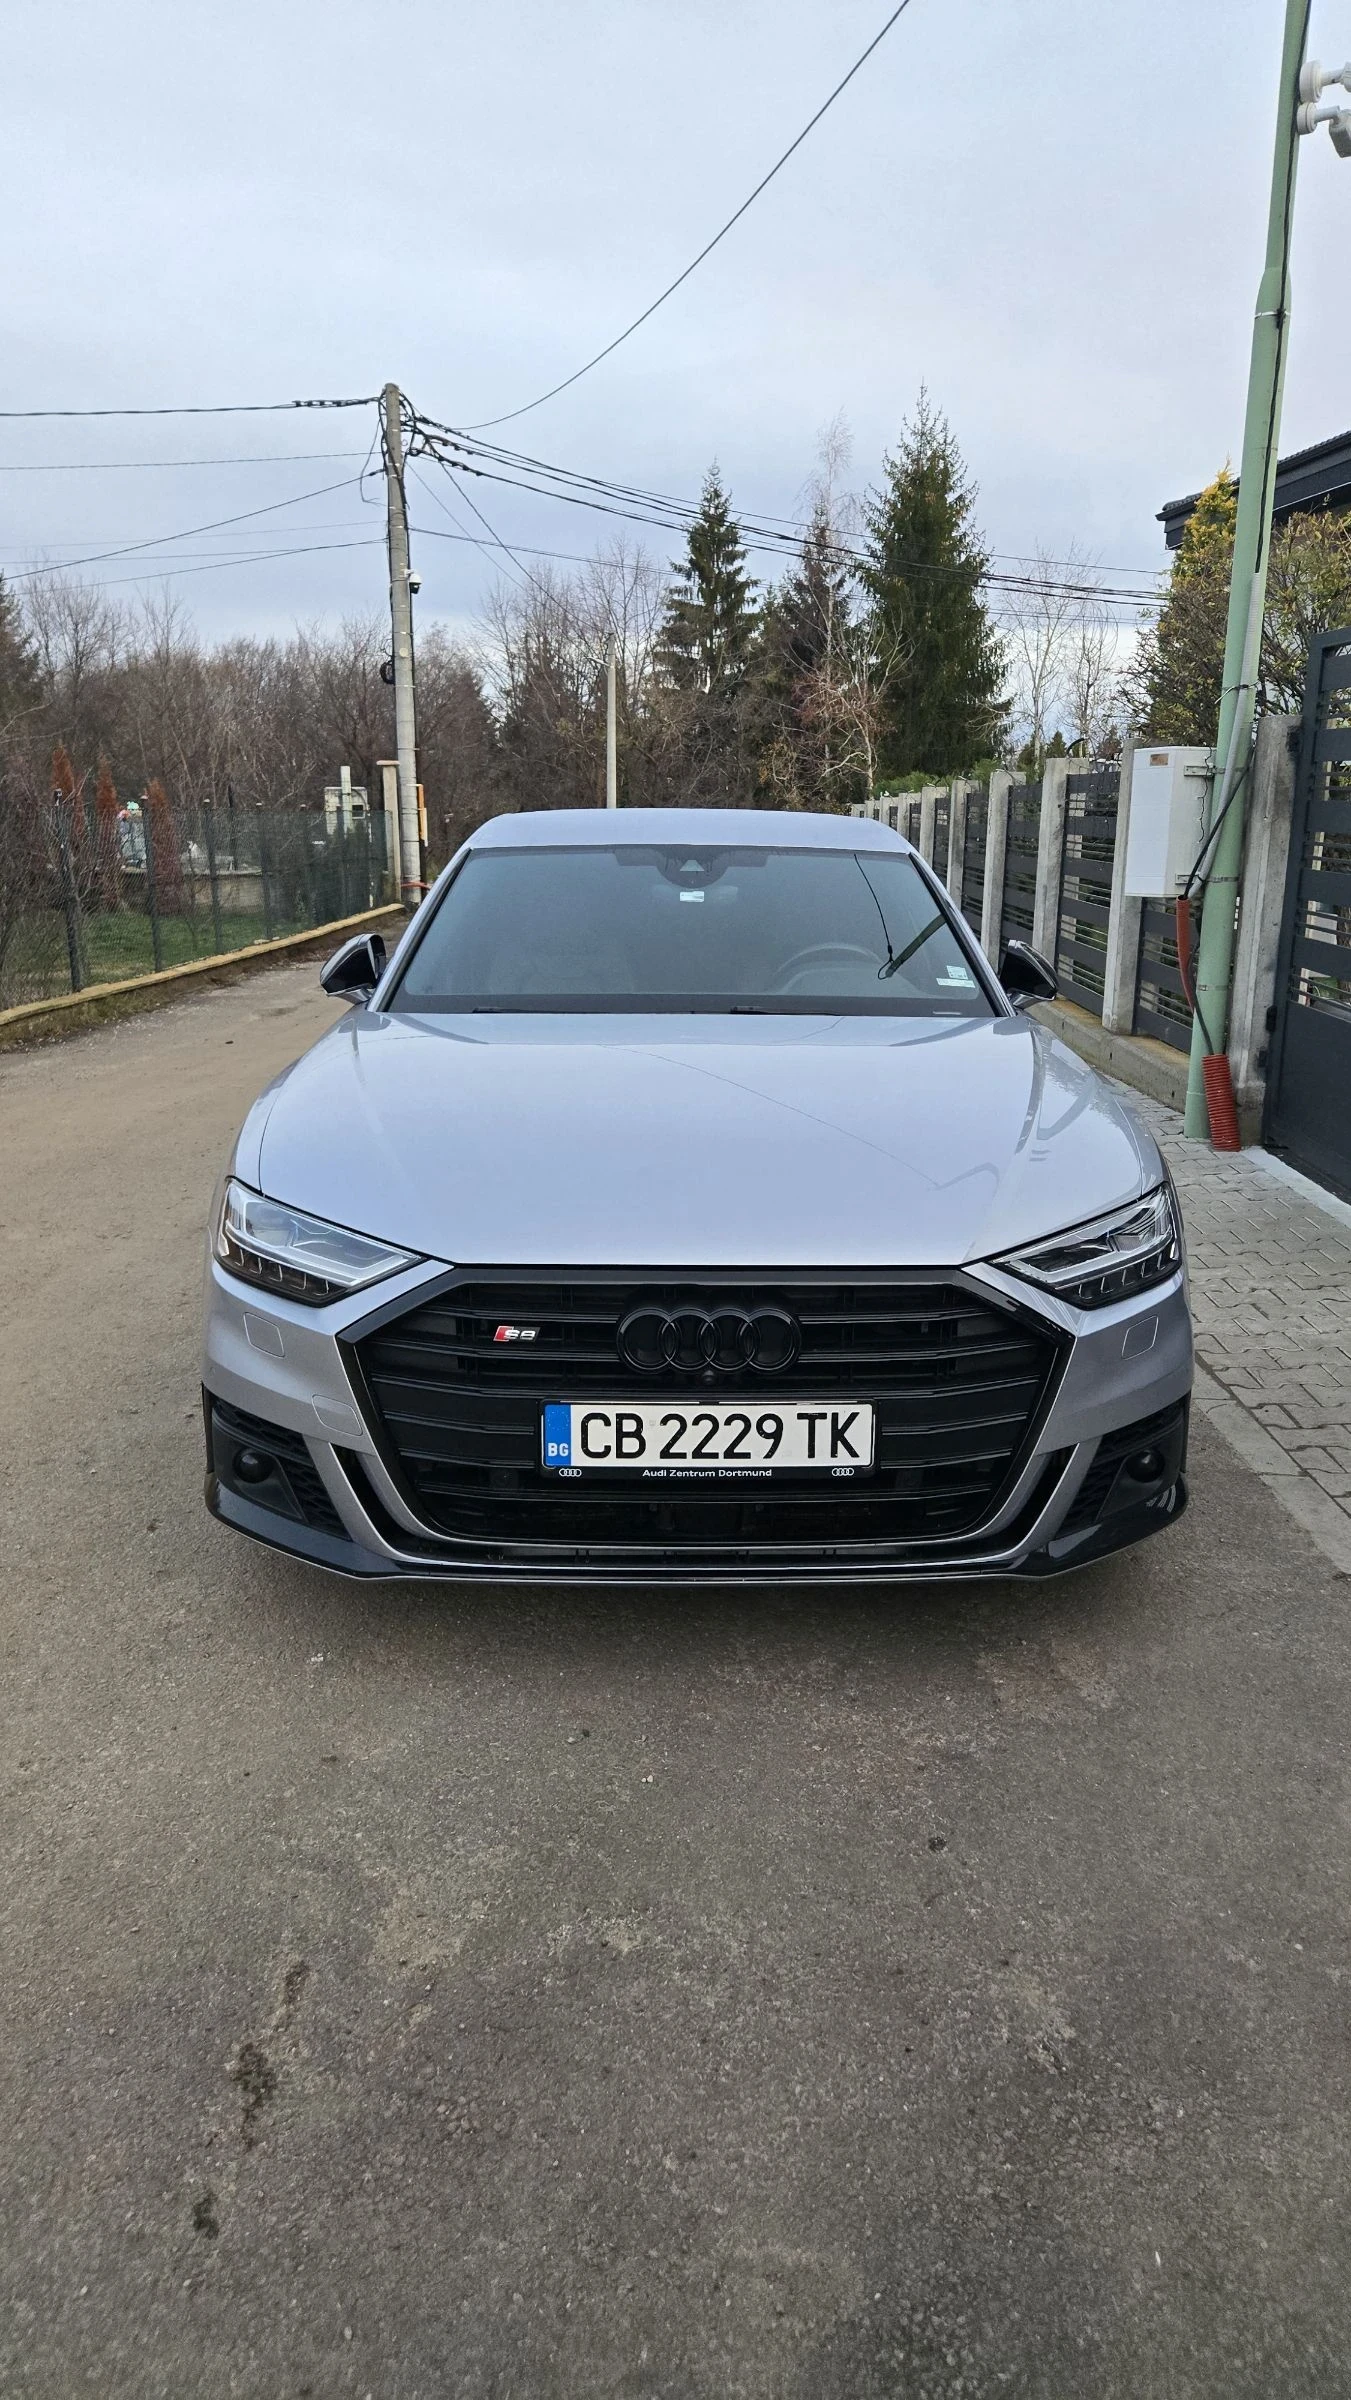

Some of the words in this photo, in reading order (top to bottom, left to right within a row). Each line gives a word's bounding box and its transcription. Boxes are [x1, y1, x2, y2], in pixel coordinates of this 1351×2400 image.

[503, 1329, 536, 1341] S8
[580, 1412, 647, 1459] CB
[659, 1413, 784, 1460] 2229
[796, 1411, 861, 1459] TK
[547, 1442, 569, 1457] BG
[642, 1469, 667, 1477] Audi
[669, 1469, 716, 1477] Zentrum
[718, 1469, 772, 1477] Dortmund
